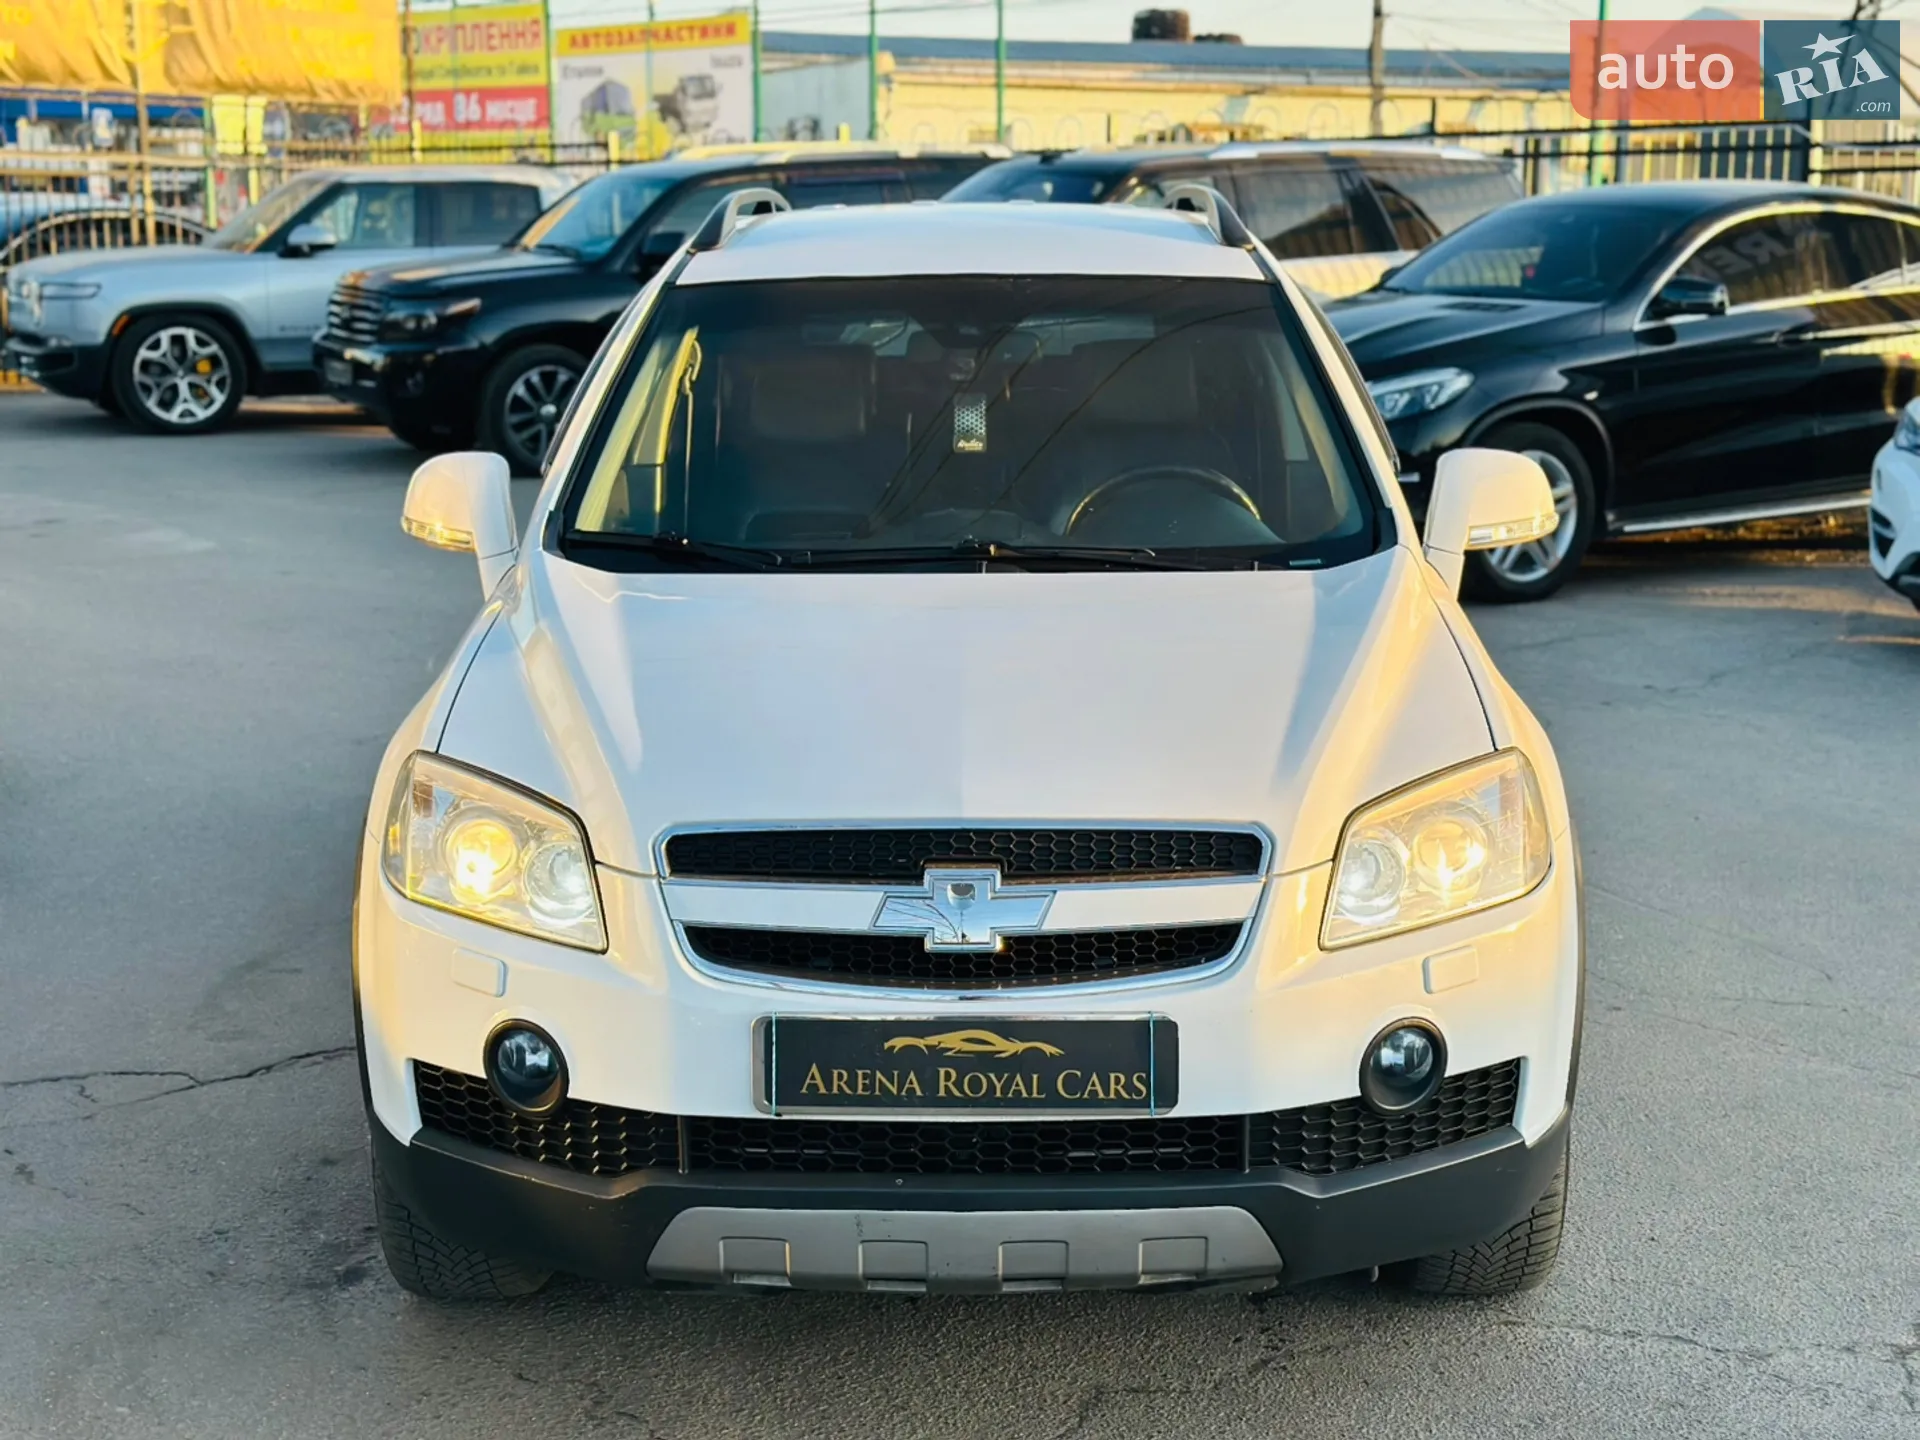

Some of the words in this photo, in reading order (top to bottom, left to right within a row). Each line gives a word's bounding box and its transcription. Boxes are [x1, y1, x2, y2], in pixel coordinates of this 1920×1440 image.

[799, 1062, 924, 1098] ARENA
[936, 1067, 1047, 1099] ROYAL
[1056, 1069, 1147, 1101] CARS
